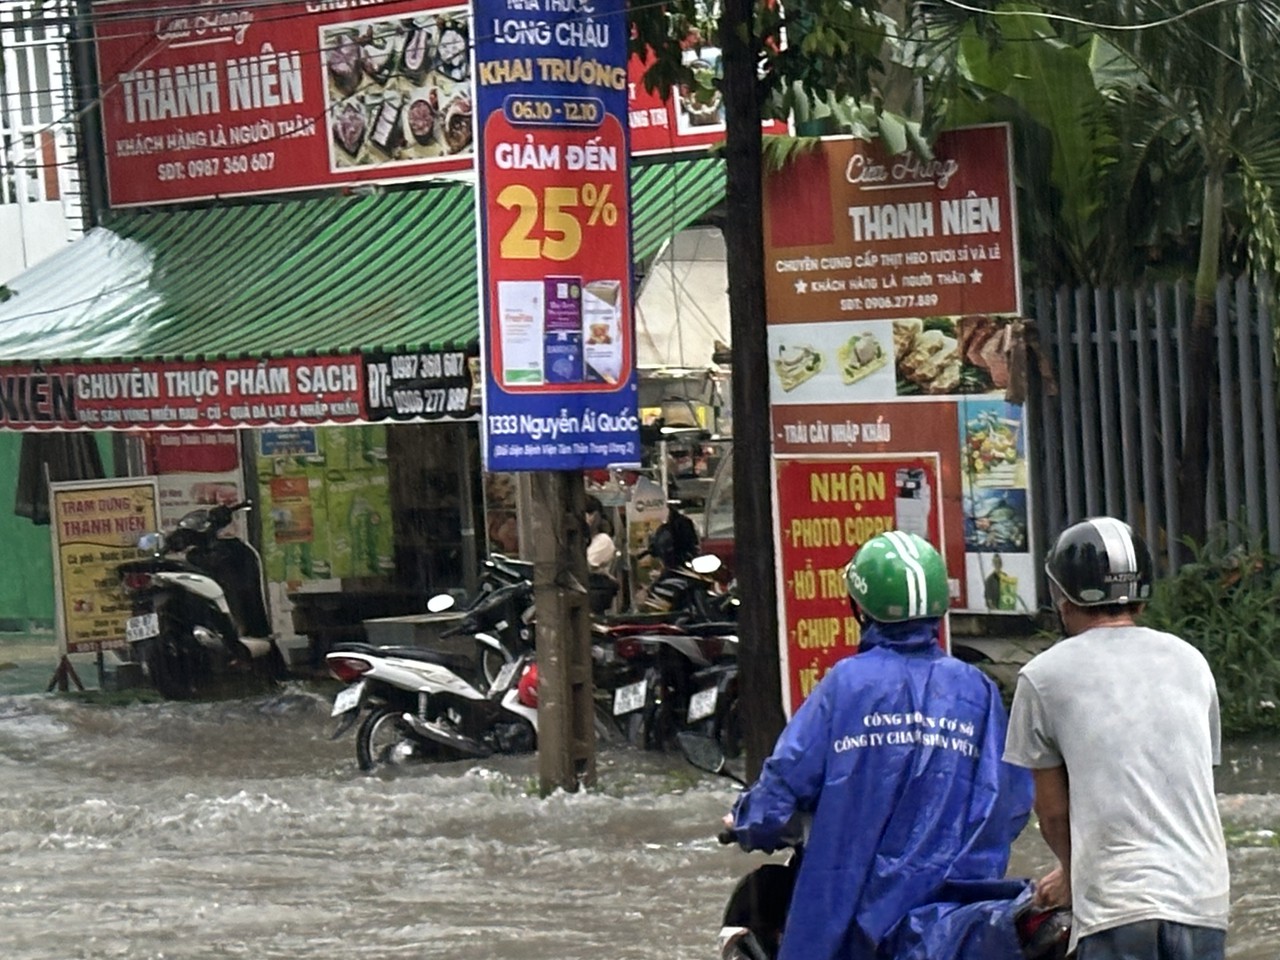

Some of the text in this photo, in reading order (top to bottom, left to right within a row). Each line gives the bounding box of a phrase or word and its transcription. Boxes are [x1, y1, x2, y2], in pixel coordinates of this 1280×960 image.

[494, 17, 609, 48] LONG CHÂU
[118, 43, 303, 123] THANH NIÊN
[479, 56, 626, 90] KHAI TRƯƠNG
[512, 100, 552, 119] 06.10
[563, 102, 598, 121] 12.10
[116, 115, 315, 157] KHÁCH HÀNG LÀ NGƯỜI THÂN
[495, 134, 617, 171] GIẢM ĐẾN
[158, 152, 275, 180] SĐT: 0987 360 607
[496, 183, 617, 261] 25%
[849, 190, 1001, 242] THANH NIÊN
[776, 256, 819, 273] CHUYÊN
[820, 255, 853, 271] CUNG
[854, 250, 879, 268] CẤP
[905, 251, 928, 265] HEO
[811, 276, 846, 292] KHÁCH
[882, 273, 898, 288] LÀ
[78, 367, 158, 399] CHUYÊN
[164, 368, 218, 402] THỰC
[226, 359, 289, 395] PHẨM
[297, 364, 357, 398] SẠCH
[489, 407, 638, 440] 1333 Nguyễn Ái Quốc
[810, 465, 886, 511] NHẬN
[63, 518, 111, 537] THANH
[791, 518, 841, 548] PHOTO
[793, 558, 816, 600] HỖ
[797, 617, 840, 654] CHỤP
[864, 712, 900, 727] CÔNG
[939, 717, 957, 732] CƠ
[834, 735, 867, 753] CÔNG
[869, 733, 884, 746] TY
